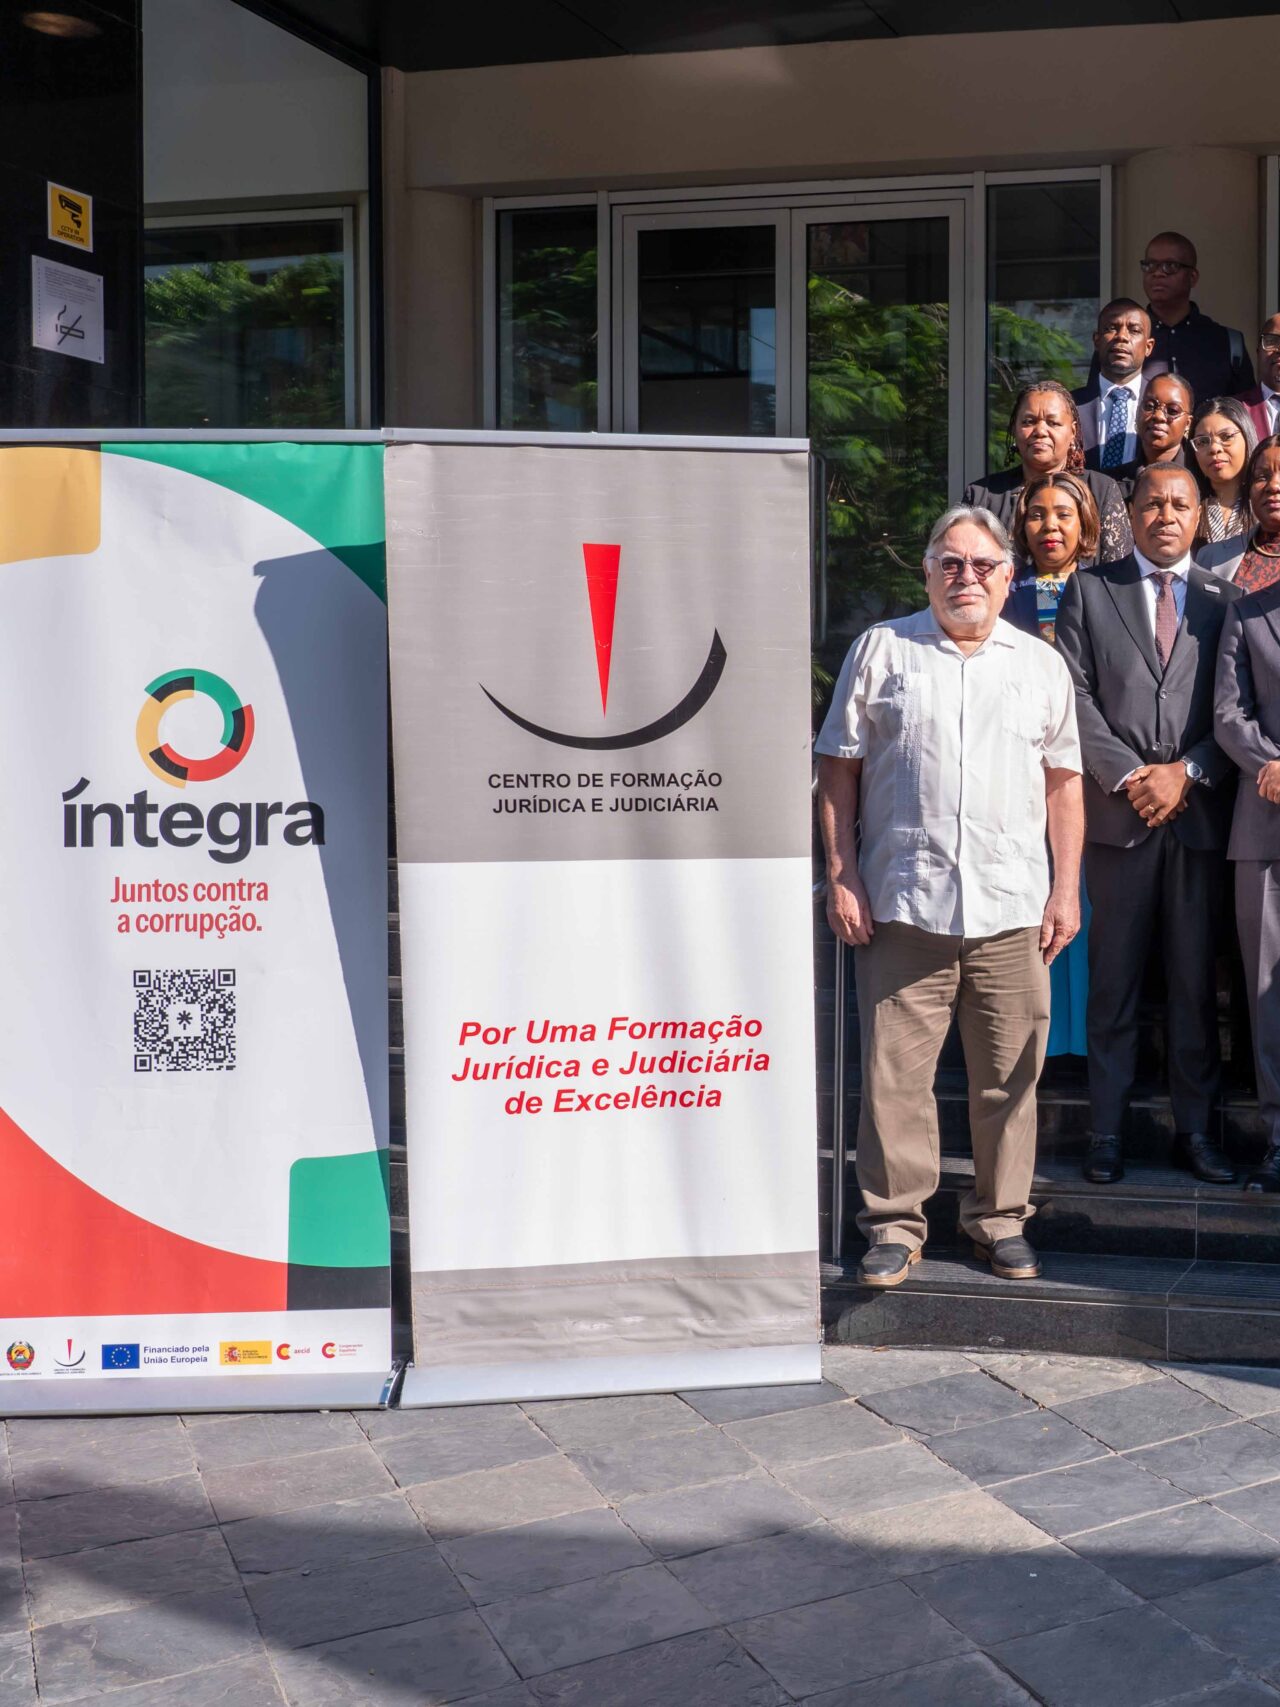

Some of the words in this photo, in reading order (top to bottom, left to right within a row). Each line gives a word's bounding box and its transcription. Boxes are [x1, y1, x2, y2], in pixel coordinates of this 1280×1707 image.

[488, 773, 571, 789] CENTRO
[577, 772, 604, 788] DE
[610, 769, 723, 791] FORMAÇÃO
[492, 795, 586, 813] JURÍDICA
[591, 798, 604, 812] E
[609, 794, 719, 812] JUDICIÁRIA
[62, 776, 326, 864] íntegra
[110, 876, 189, 903] Juntos
[193, 878, 269, 902] contra
[117, 913, 130, 933] a
[135, 905, 263, 939] corrupção.
[459, 1021, 516, 1046] Por
[526, 1019, 597, 1044] Uma
[608, 1014, 763, 1044] Formação
[451, 1055, 580, 1082] Jurídica
[592, 1058, 609, 1076] e
[619, 1048, 771, 1075] Judiciária
[504, 1091, 543, 1115] de
[553, 1084, 722, 1113] Excelência
[143, 1345, 190, 1353] Financiado
[192, 1345, 210, 1354] pela
[143, 1356, 169, 1364] União
[170, 1355, 208, 1364] Europeia
